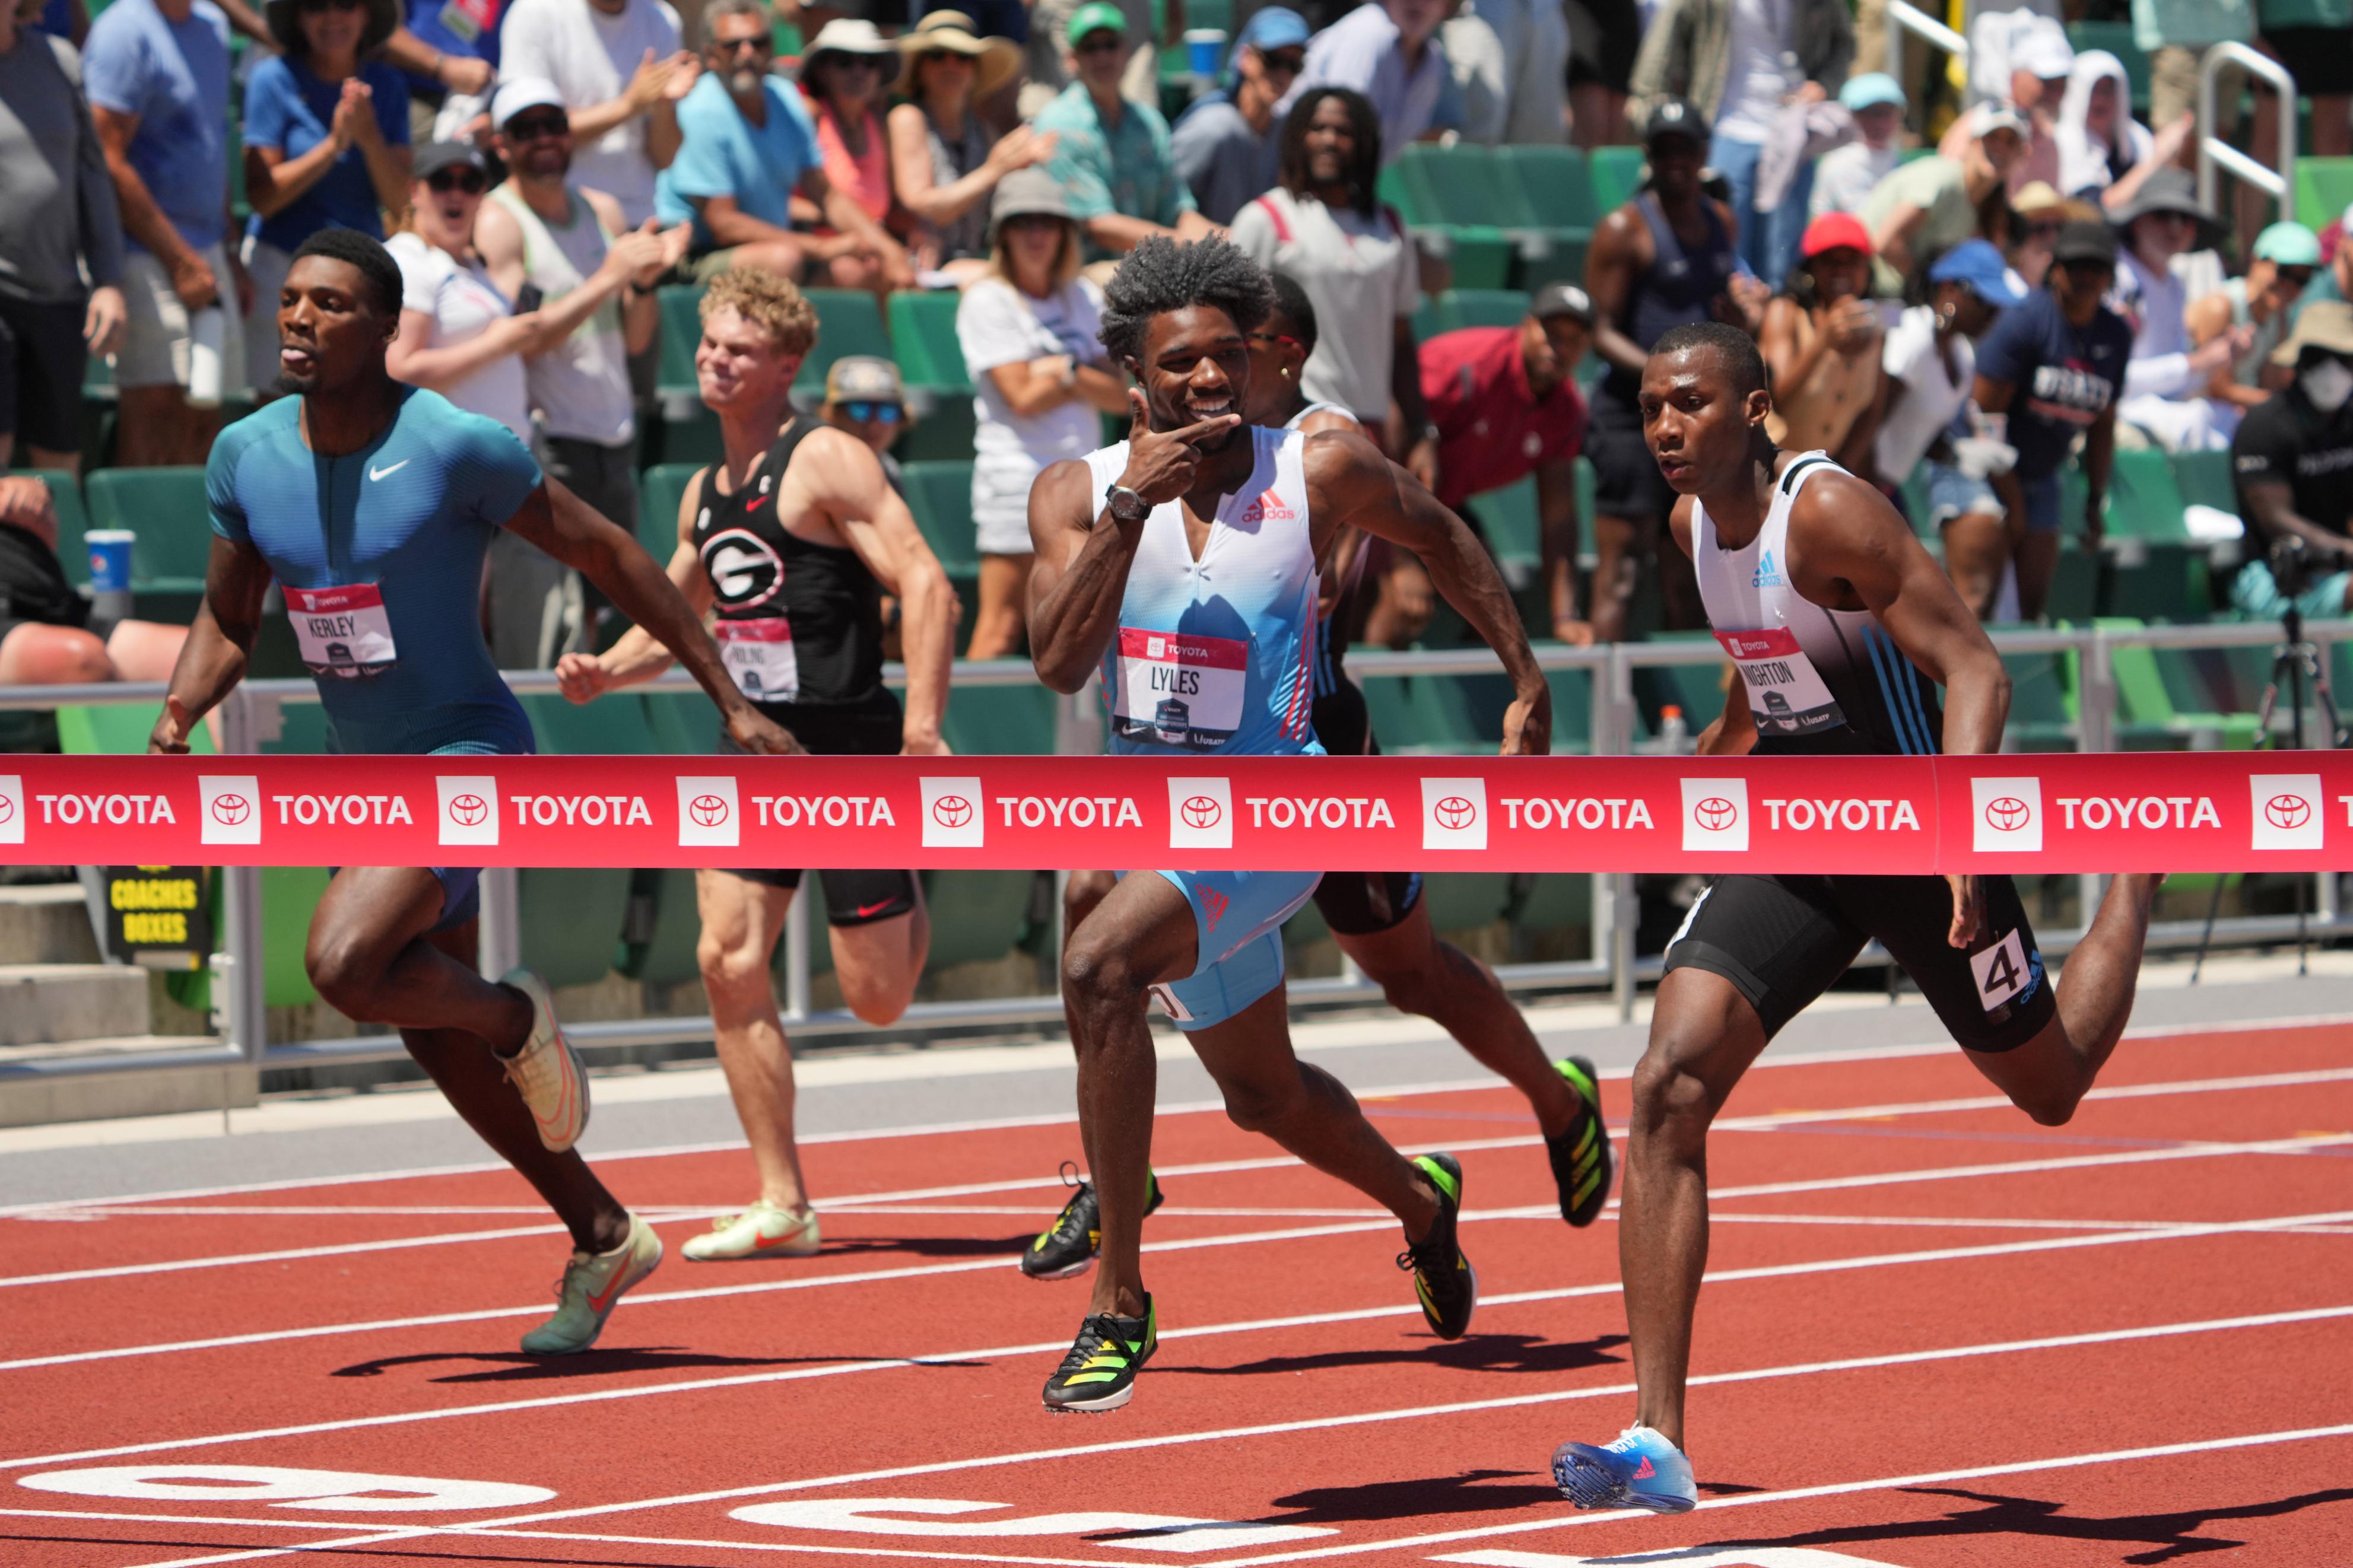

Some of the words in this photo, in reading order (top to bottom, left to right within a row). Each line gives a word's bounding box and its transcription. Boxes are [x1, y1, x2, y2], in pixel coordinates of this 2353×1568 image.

[1241, 508, 1294, 523] adidas
[1752, 574, 1782, 588] adidas
[306, 615, 355, 638] KERLEY
[1167, 644, 1208, 658] TOYOTA
[1742, 641, 1770, 651] TOYOTA
[1151, 666, 1200, 695] LYLES
[1810, 714, 1830, 724] USATF
[36, 794, 176, 824] TOYOTA
[273, 795, 413, 825] TOYOTA
[511, 796, 652, 826] TOYOTA
[752, 796, 895, 826] TOYOTA
[996, 797, 1142, 828] TOYOTA
[1246, 797, 1395, 828] TOYOTA
[1501, 799, 1654, 829] TOYOTA
[1763, 799, 1920, 831] TOYOTA
[2057, 797, 2221, 830] TOYOTA
[111, 879, 198, 911] COACHES
[123, 911, 188, 943] BOXES
[1984, 943, 2020, 994] 4
[1633, 1470, 1656, 1480] adidas
